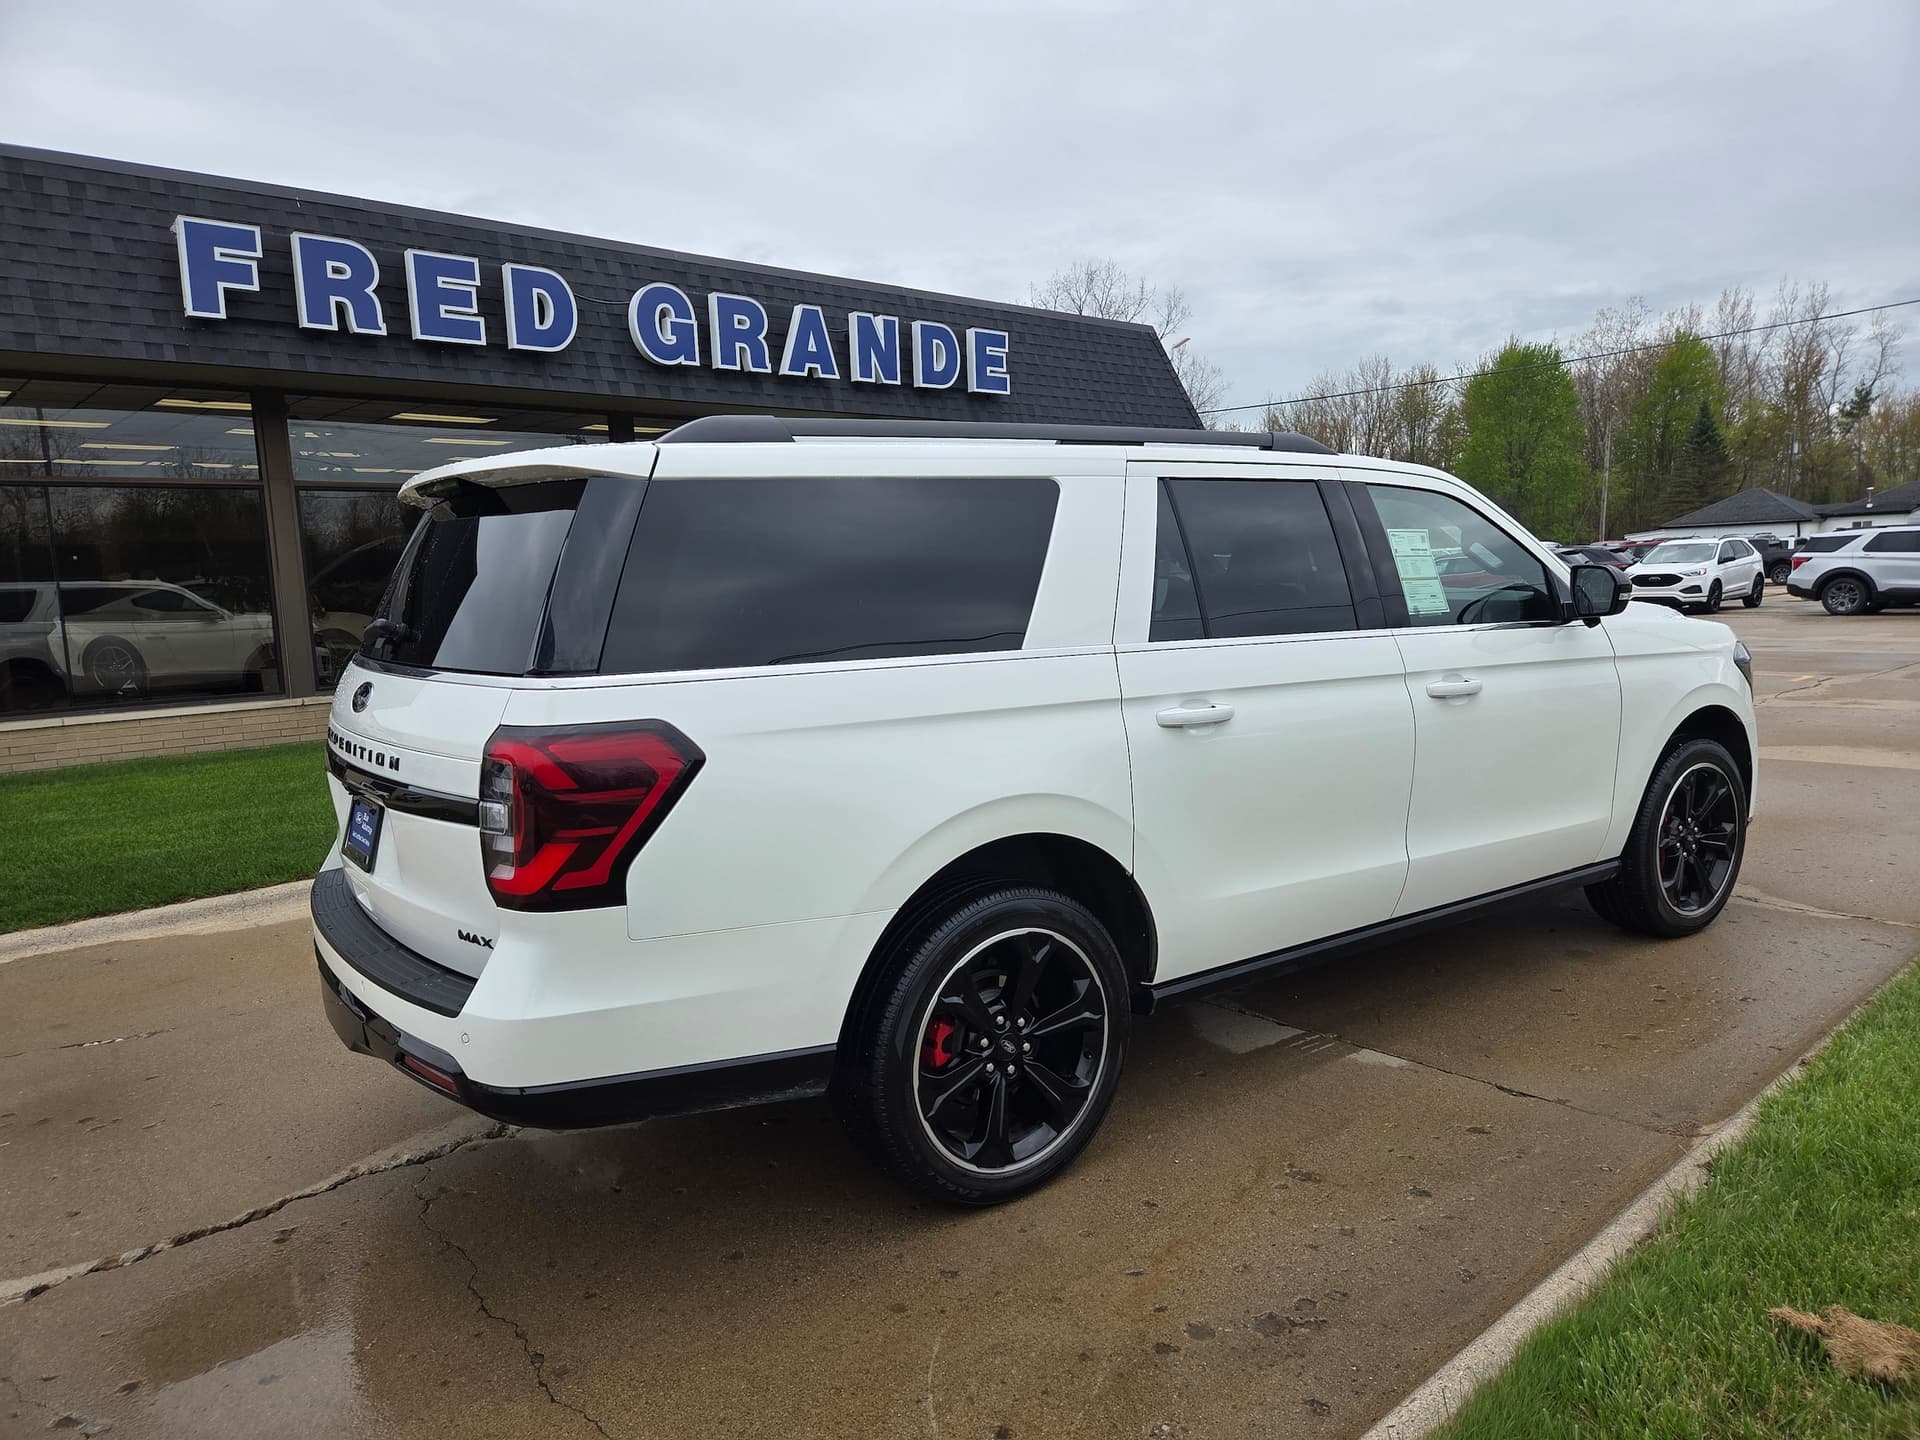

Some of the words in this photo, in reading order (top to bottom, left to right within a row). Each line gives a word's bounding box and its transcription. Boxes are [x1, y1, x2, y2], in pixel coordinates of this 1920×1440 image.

[176, 215, 578, 353] FRED
[628, 282, 1011, 395] GRANDE
[457, 929, 494, 950] MAX
